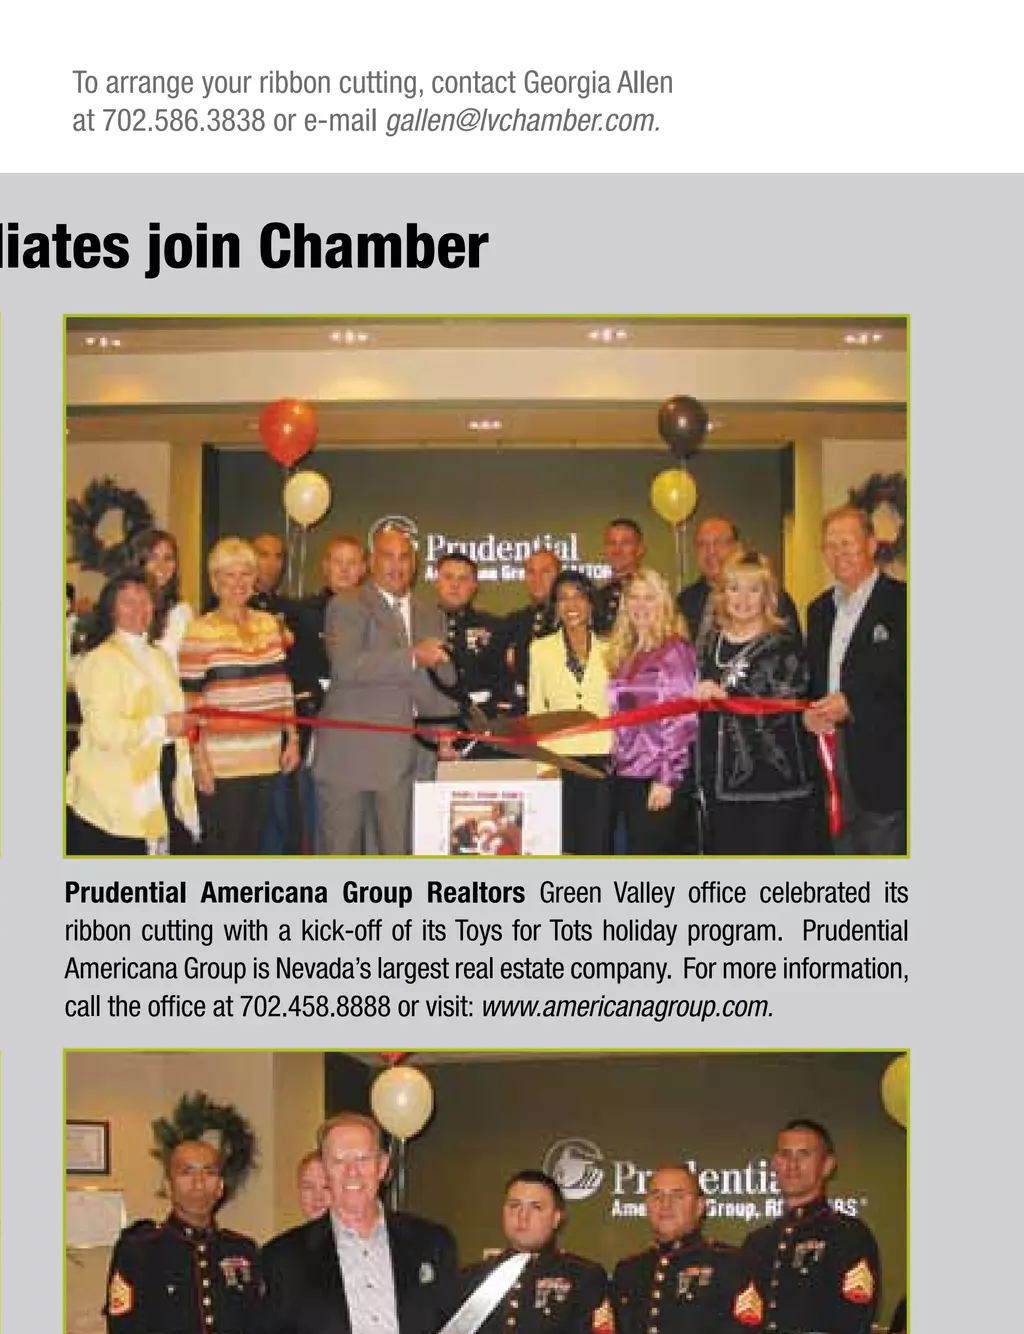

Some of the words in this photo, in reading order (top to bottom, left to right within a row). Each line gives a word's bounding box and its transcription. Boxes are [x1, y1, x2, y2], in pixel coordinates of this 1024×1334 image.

[72, 70, 98, 93] To
[106, 75, 193, 99] arrange
[202, 76, 252, 98] your
[260, 70, 330, 93] ribbon
[340, 70, 423, 99] cutting,
[432, 71, 516, 93] contact
[524, 70, 611, 99] Georgia
[617, 70, 672, 93] Allen
[73, 109, 95, 131] at
[103, 108, 265, 131] 702.586.3838
[274, 113, 296, 131] or
[305, 108, 376, 131] e-mail
[386, 108, 659, 136] gallen@lvchamber.com.
[145, 222, 240, 279] join
[260, 222, 489, 269] Chamber
[66, 881, 186, 903] Prudential
[200, 881, 327, 903] Americana
[343, 881, 412, 908] Group
[428, 881, 525, 903] Realtors
[540, 881, 601, 903] Green
[614, 881, 675, 908] Valley
[689, 881, 746, 903] office
[760, 881, 870, 903] celebrated
[885, 881, 908, 903] its
[65, 995, 100, 1017] call
[107, 995, 140, 1017] the
[148, 995, 205, 1017] office
[213, 996, 234, 1017] at
[240, 995, 390, 1017] 702.458.8888
[398, 1000, 419, 1017] or
[426, 995, 473, 1017] visit:
[483, 995, 772, 1022] www.americanagroup.com.
